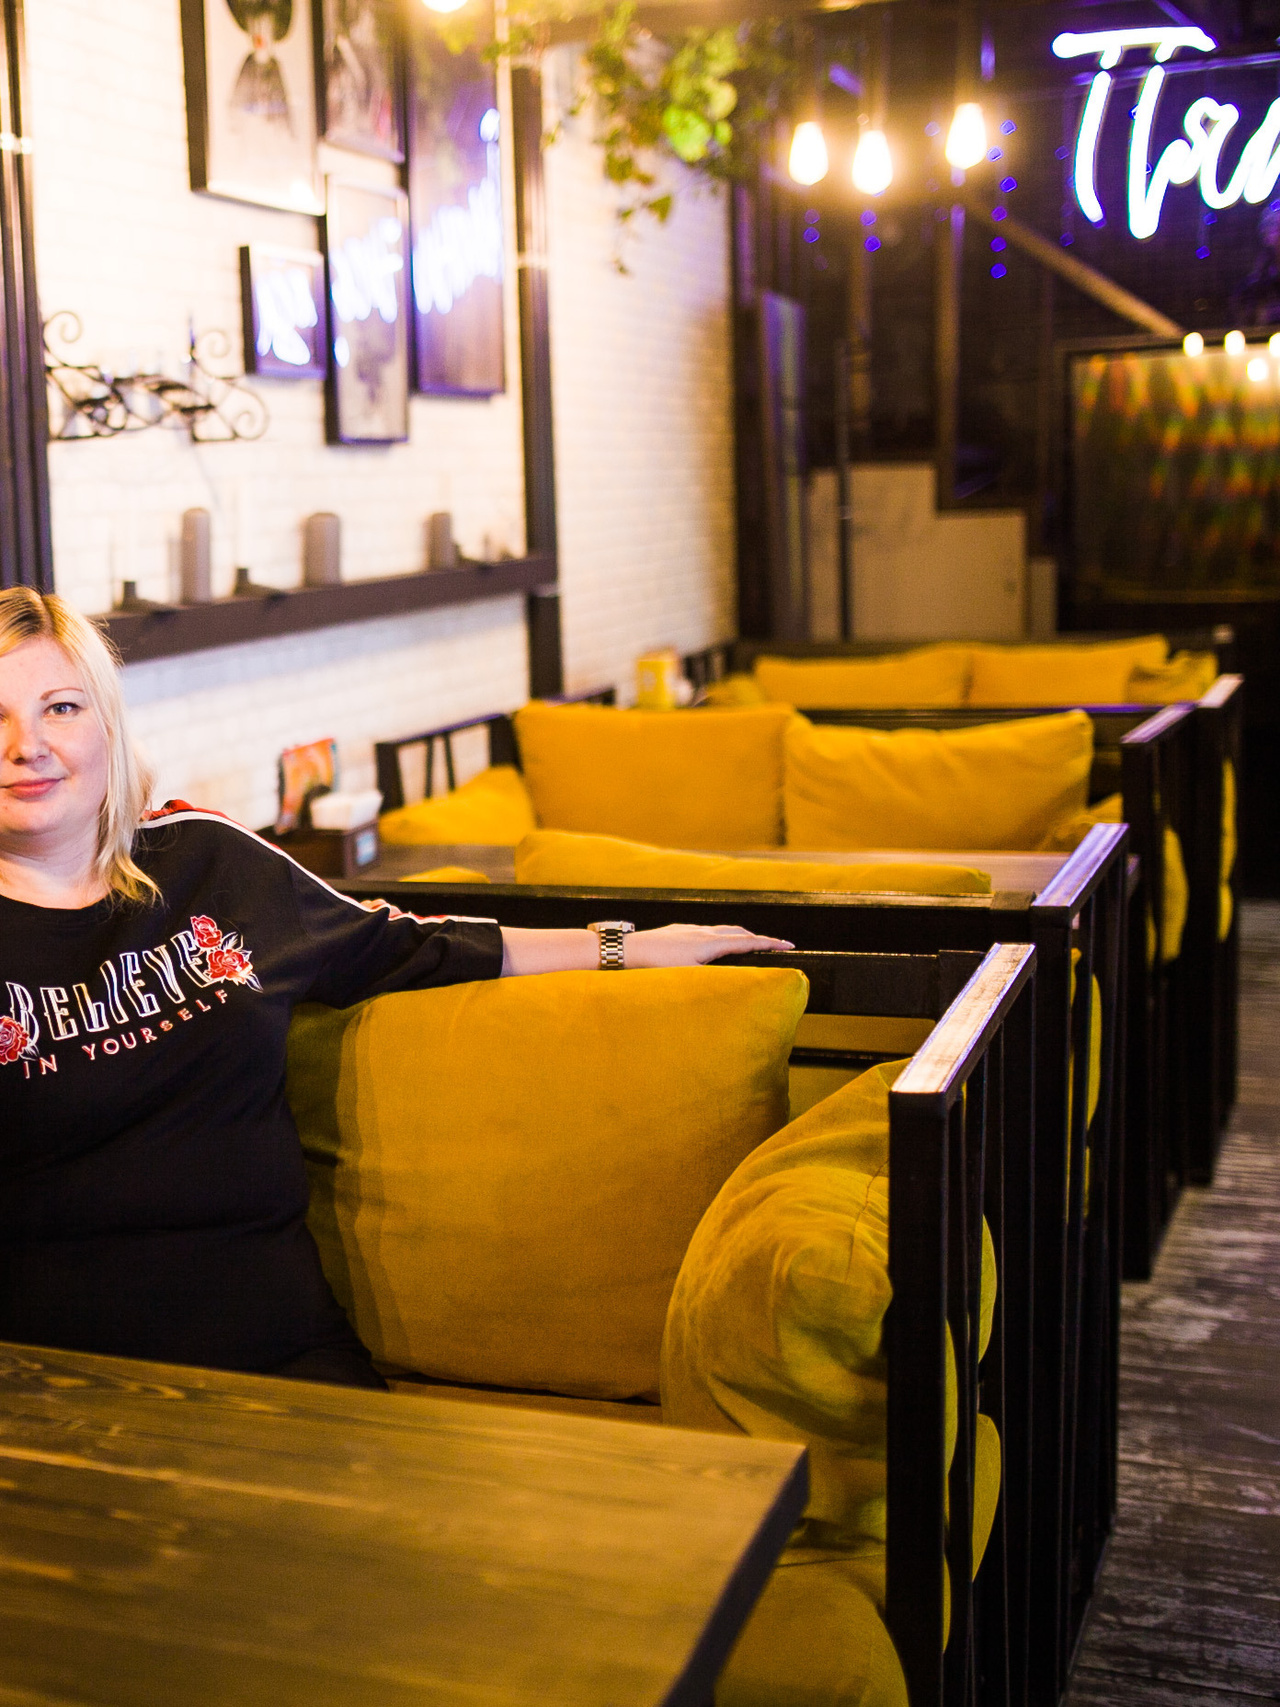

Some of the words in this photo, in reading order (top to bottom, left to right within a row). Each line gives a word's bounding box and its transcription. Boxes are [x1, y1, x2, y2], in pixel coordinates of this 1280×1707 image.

[5, 930, 222, 1046] BELIEVE
[23, 1054, 58, 1079] IN
[81, 989, 228, 1061] YOURSELF
